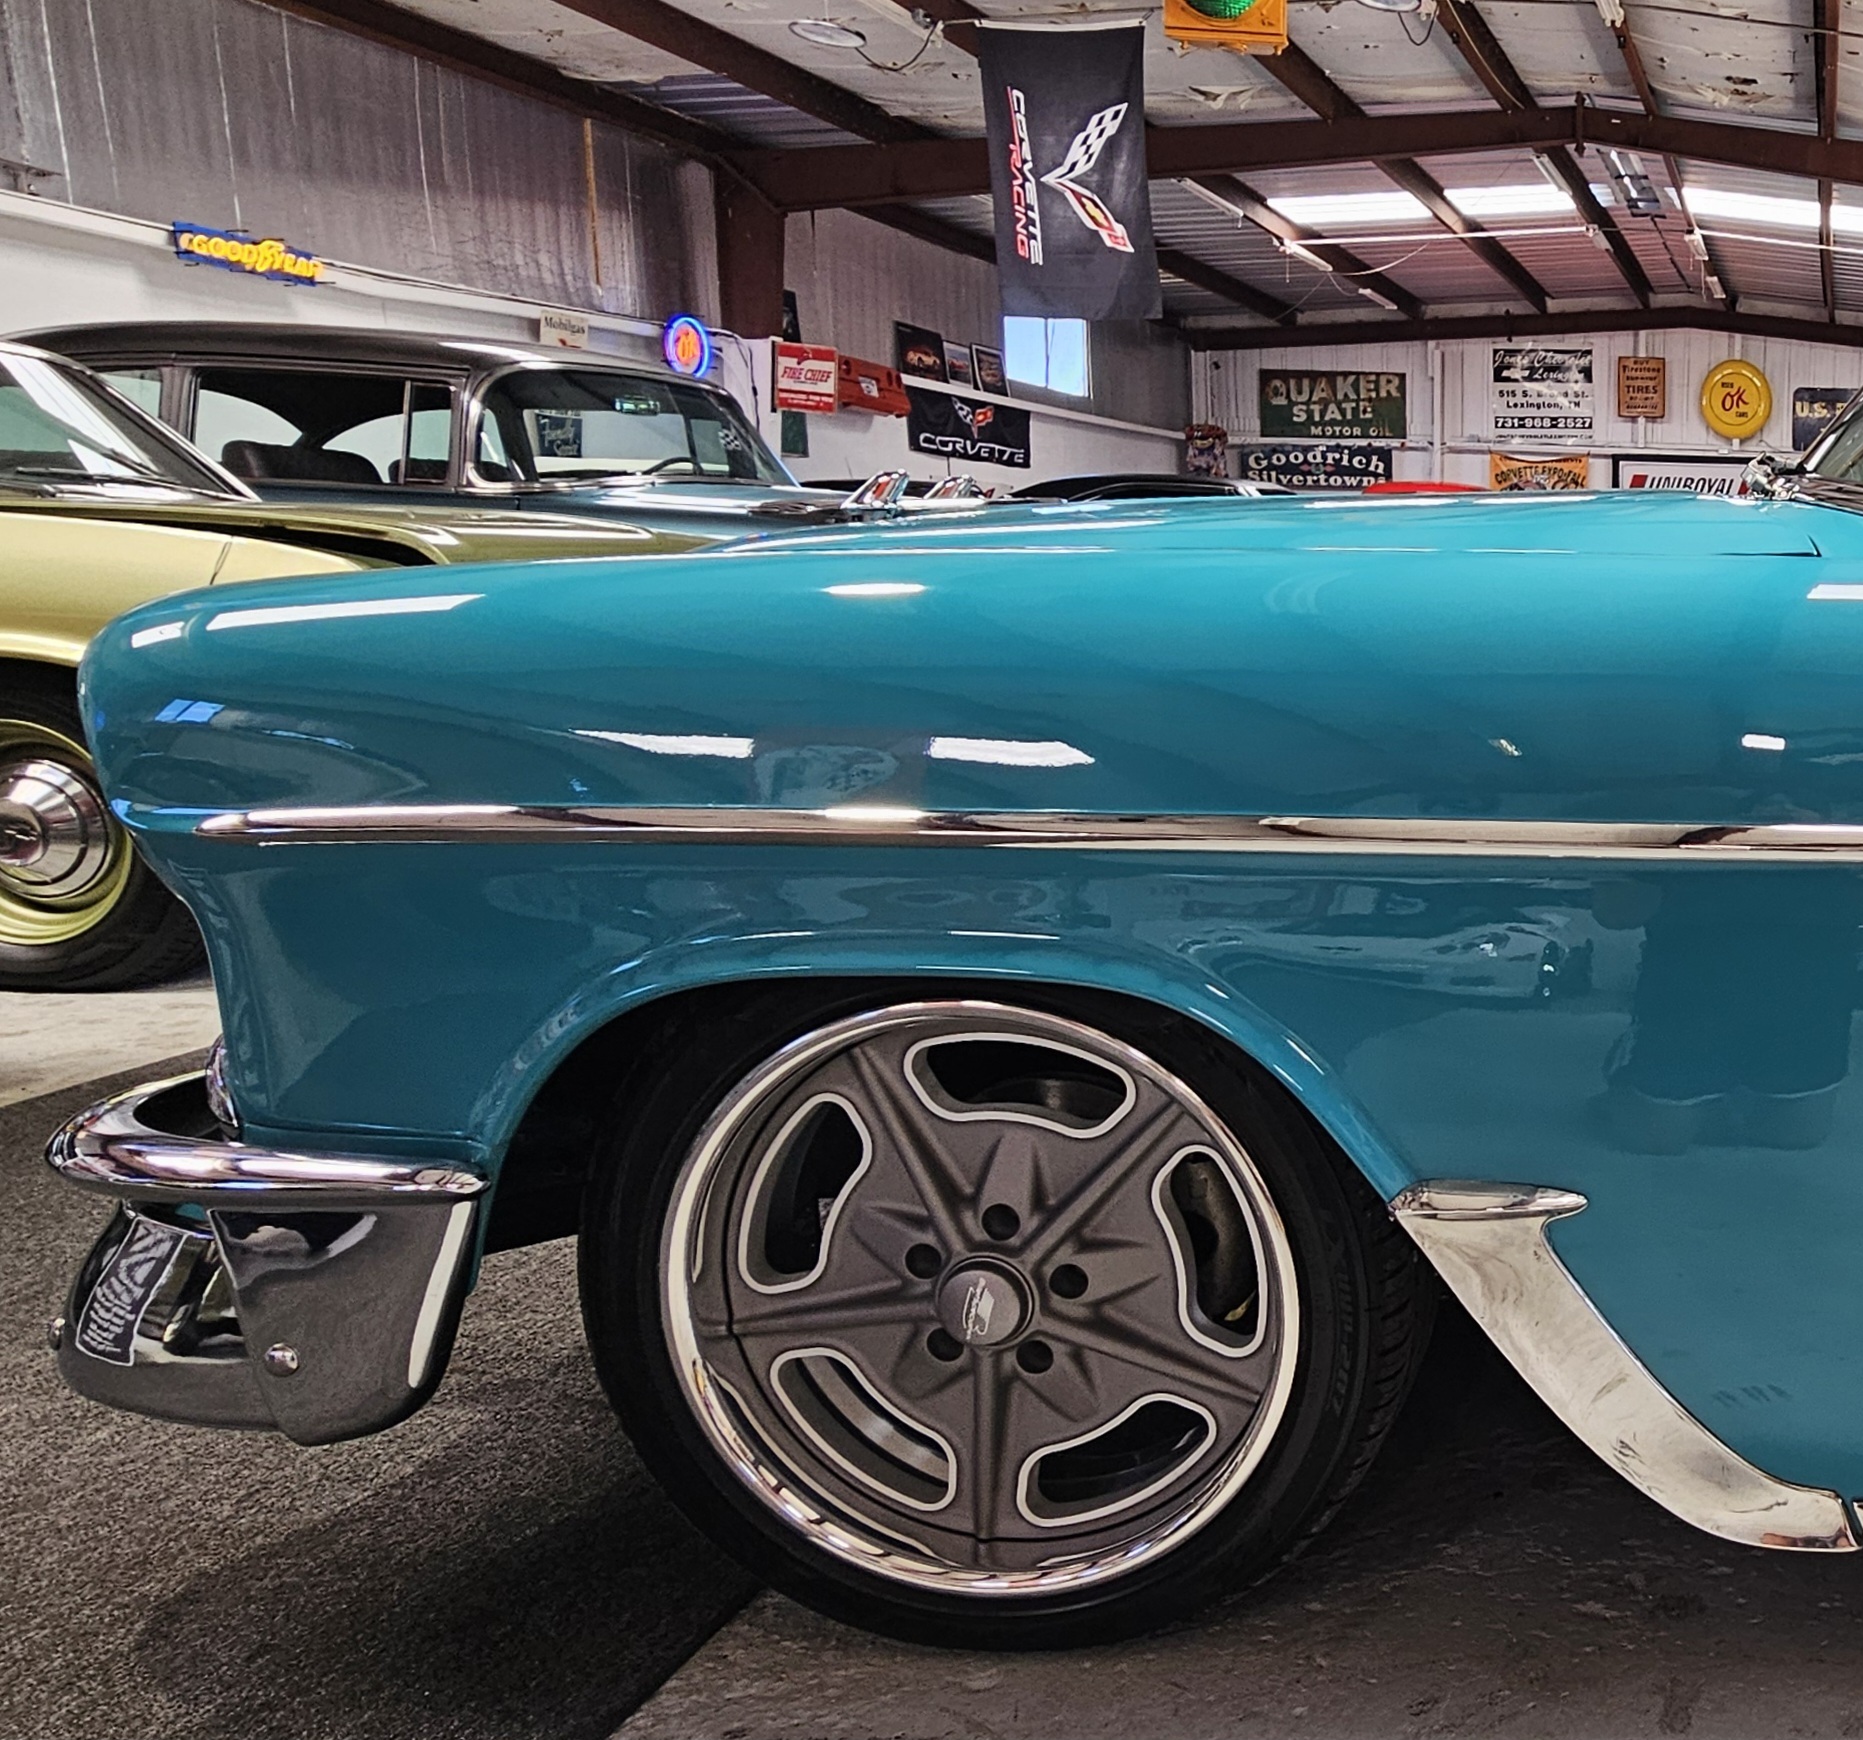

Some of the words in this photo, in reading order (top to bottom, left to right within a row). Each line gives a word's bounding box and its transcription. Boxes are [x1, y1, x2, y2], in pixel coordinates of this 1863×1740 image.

[1011, 88, 1043, 266] CORVETTE
[1008, 142, 1030, 260] RACING
[544, 315, 586, 335] Mobilgas
[781, 366, 805, 380] FIRE
[804, 368, 833, 382] CHIEF
[1265, 374, 1401, 406] QUAKER
[1498, 389, 1517, 399] 515
[1521, 389, 1533, 399] S.
[1573, 389, 1590, 399] St.
[1625, 384, 1658, 395] TIRES
[1721, 386, 1750, 412] OK
[1293, 401, 1373, 422] STATE
[1506, 400, 1563, 411] Lexington,
[1794, 401, 1831, 418] U.S.
[1310, 426, 1362, 437] MOTOR
[1369, 427, 1394, 437] OIL
[1495, 417, 1592, 429] 731-968-2527
[919, 432, 1026, 463] CORVETTE
[1248, 446, 1386, 475] Goodrich
[1494, 465, 1541, 485] CORVETTE
